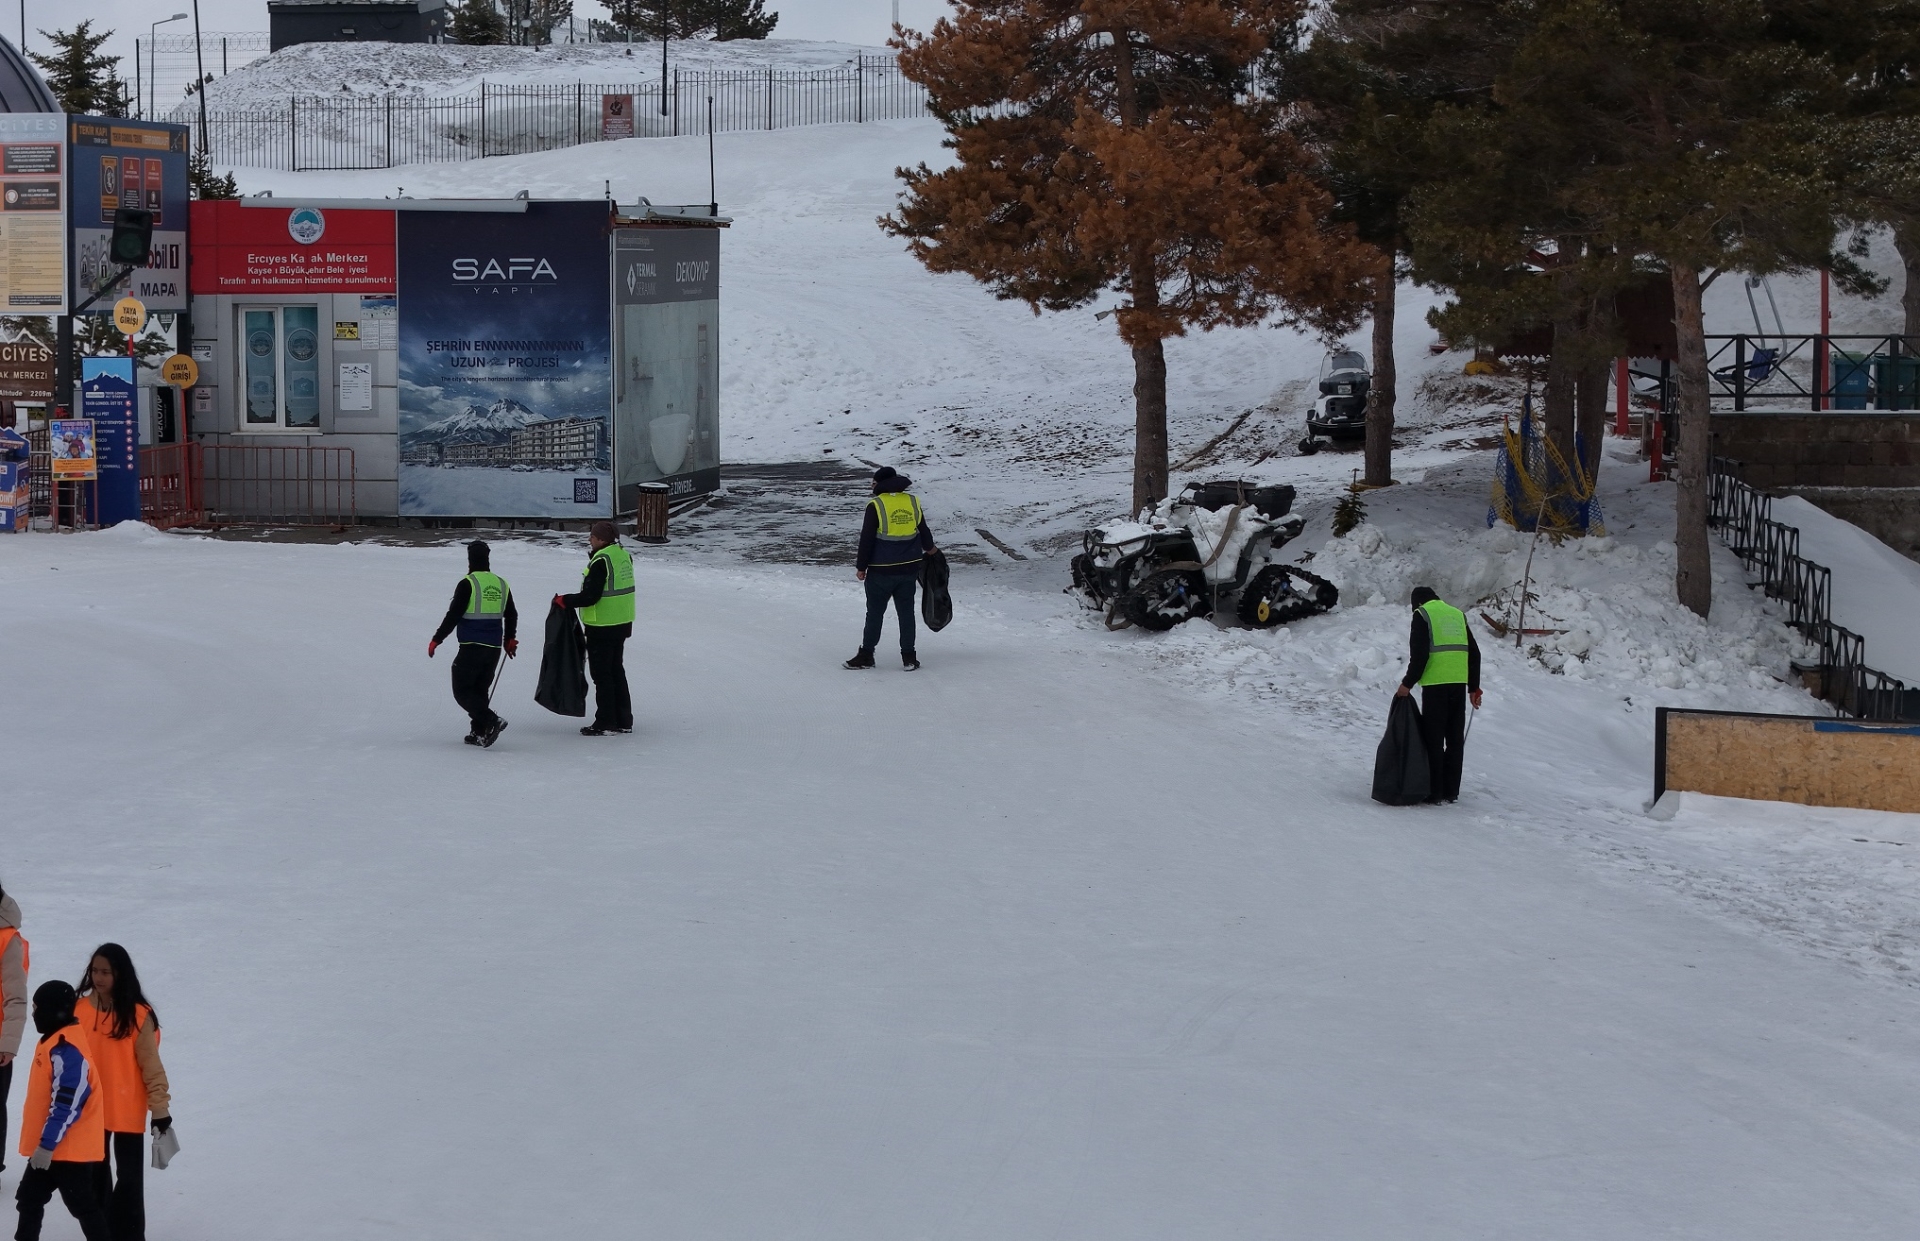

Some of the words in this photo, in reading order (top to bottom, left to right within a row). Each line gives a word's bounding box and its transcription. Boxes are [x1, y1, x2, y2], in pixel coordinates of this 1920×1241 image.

[95, 126, 108, 137] KAPI
[137, 244, 167, 269] obil
[452, 257, 558, 281] SAFA
[636, 263, 657, 277] TERMAL
[675, 260, 709, 283] DEKOYAP
[304, 276, 343, 284] hizmetine
[473, 287, 533, 295] YAPI
[122, 306, 137, 316] YAYA
[426, 338, 471, 354] ŞEHRİN
[172, 363, 188, 371] YAYA
[451, 356, 486, 368] UZUN
[508, 355, 559, 368] PROJESİ
[13, 370, 48, 380] MERKEZİ
[451, 376, 466, 384] city's
